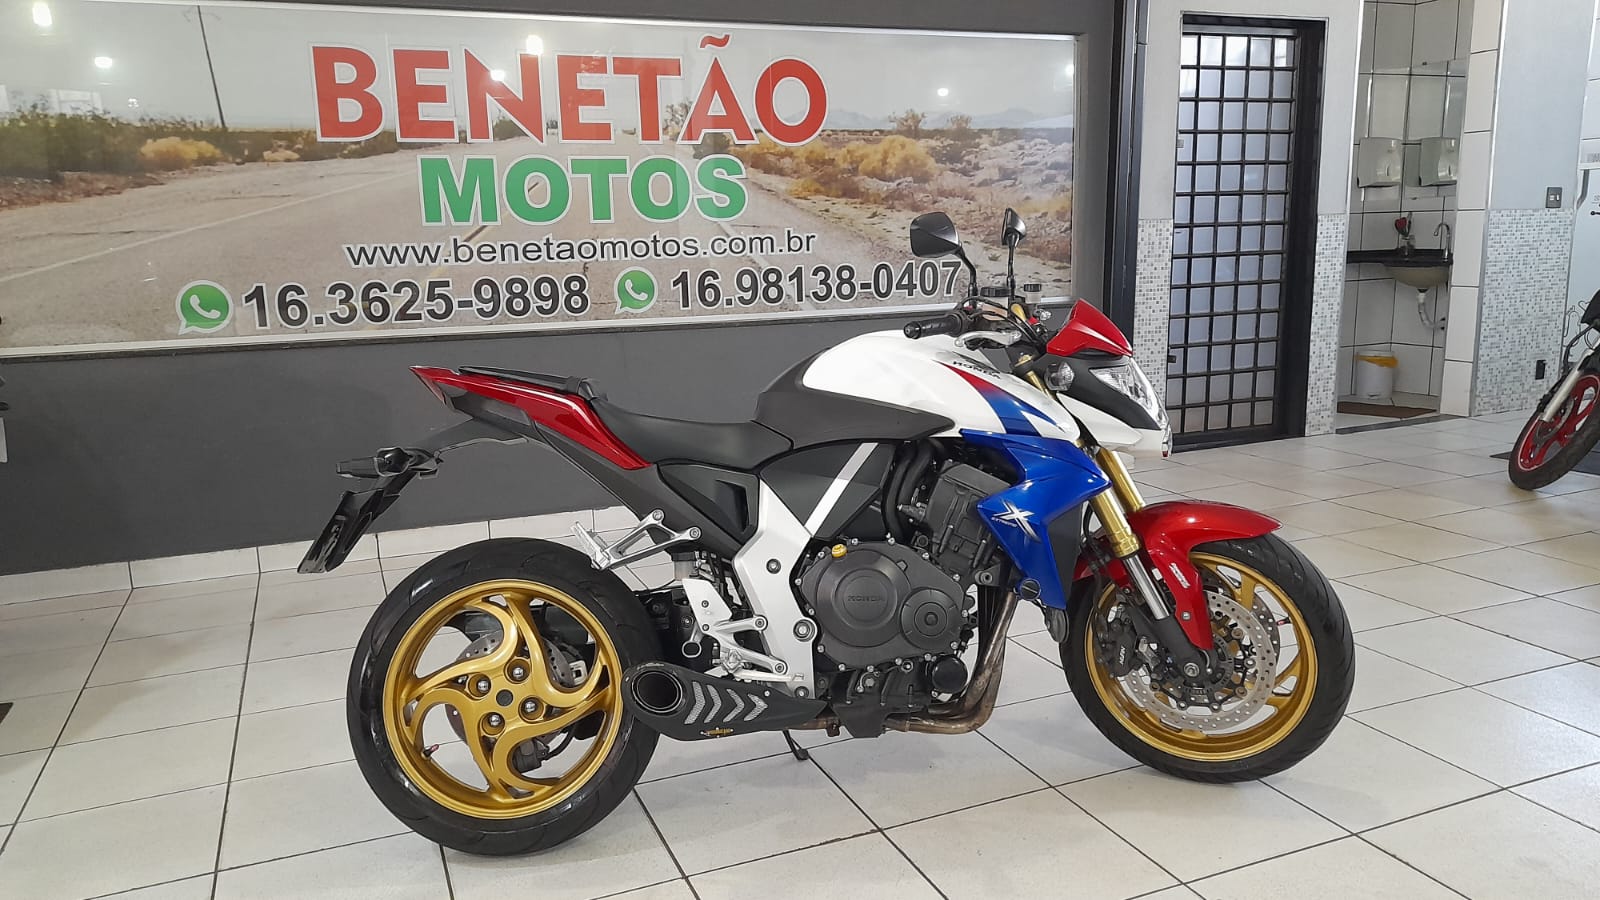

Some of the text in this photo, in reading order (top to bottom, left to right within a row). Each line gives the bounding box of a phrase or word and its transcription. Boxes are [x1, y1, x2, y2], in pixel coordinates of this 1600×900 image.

[311, 34, 828, 145] BENETÃO
[420, 156, 748, 226] MOTOS
[345, 230, 816, 268] www.benetaomotos.com.br
[242, 274, 590, 329] 16.3625-9898
[672, 260, 963, 310] 16.98138-0407
